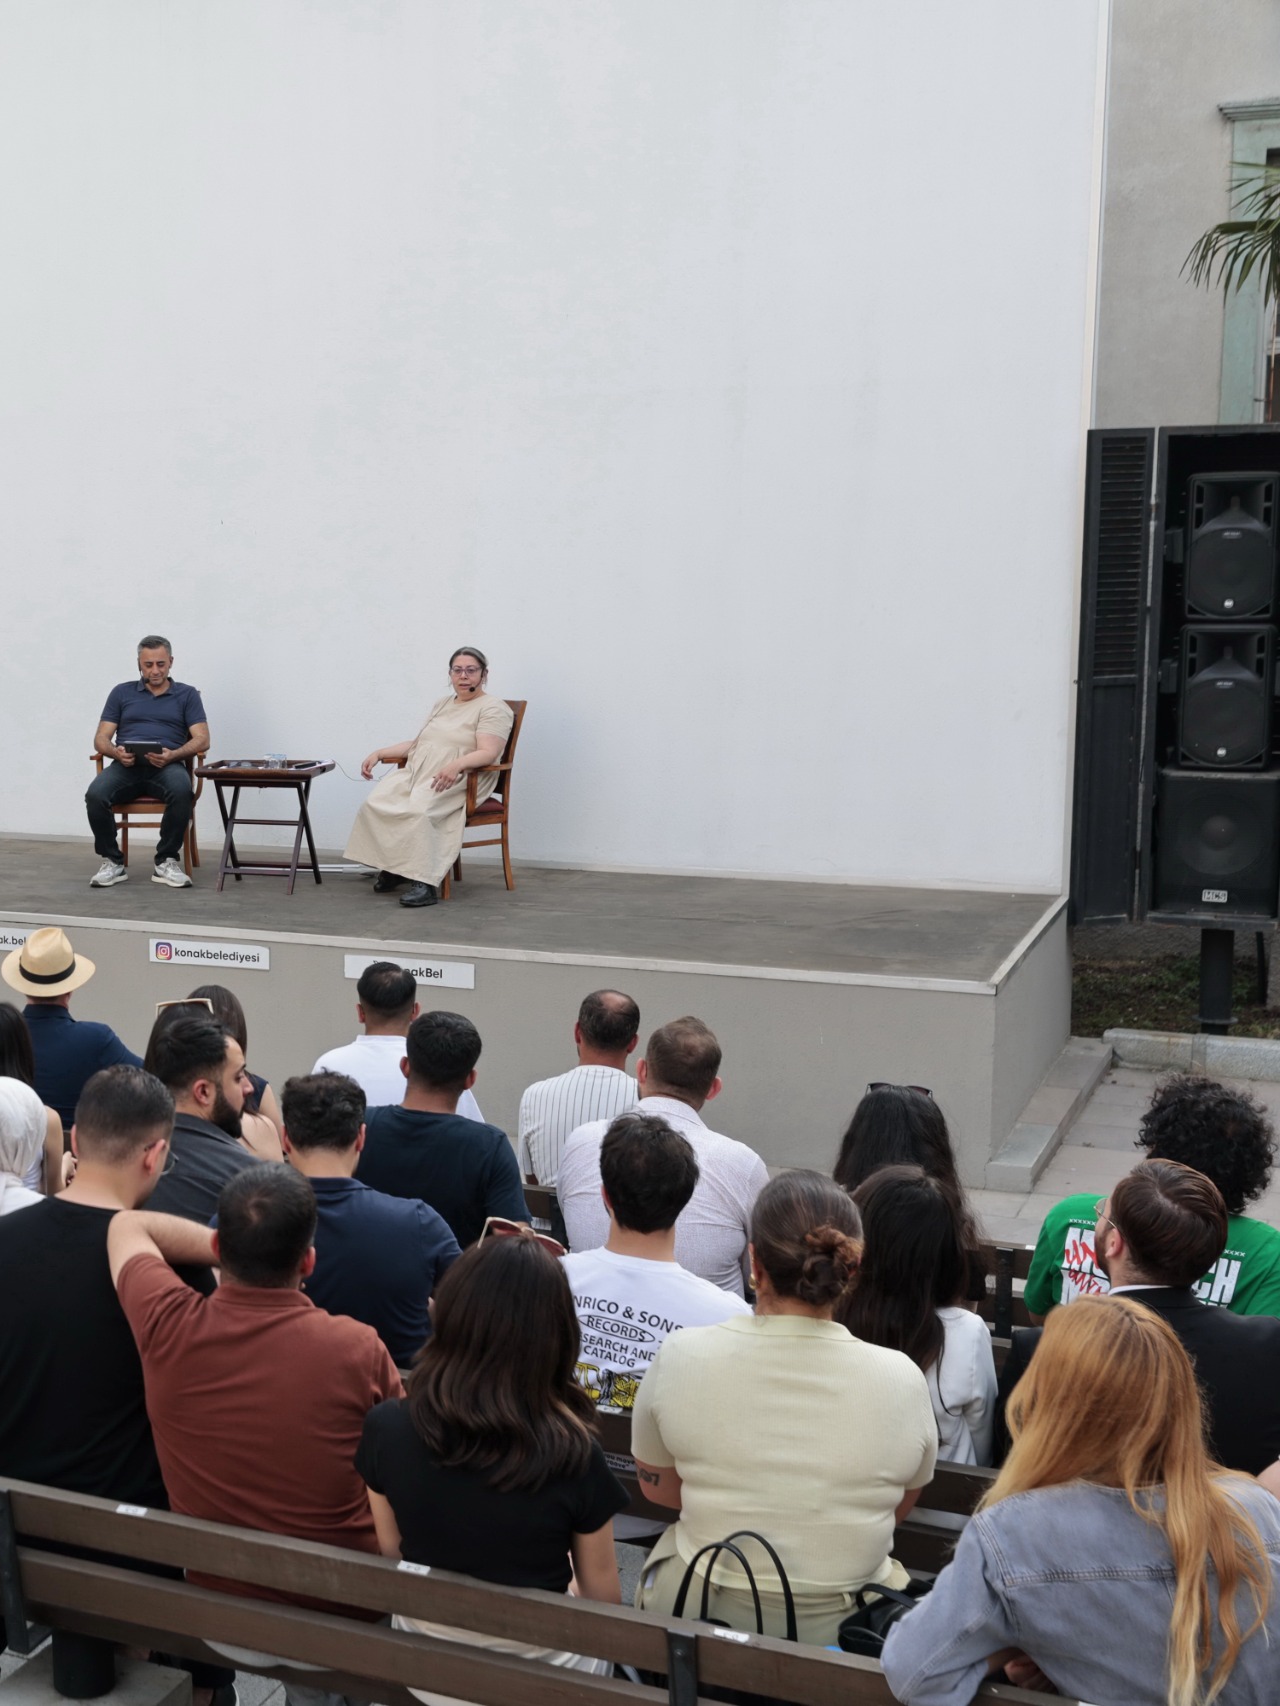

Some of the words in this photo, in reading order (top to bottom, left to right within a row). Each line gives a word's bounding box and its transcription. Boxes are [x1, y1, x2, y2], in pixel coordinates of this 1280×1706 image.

[174, 948, 260, 964] konakbelediyesi
[573, 1295, 619, 1315] NRICO
[622, 1305, 635, 1320] &
[586, 1315, 646, 1342] RECORDS
[581, 1333, 629, 1354] SEARCH
[583, 1345, 636, 1368] CATALOG
